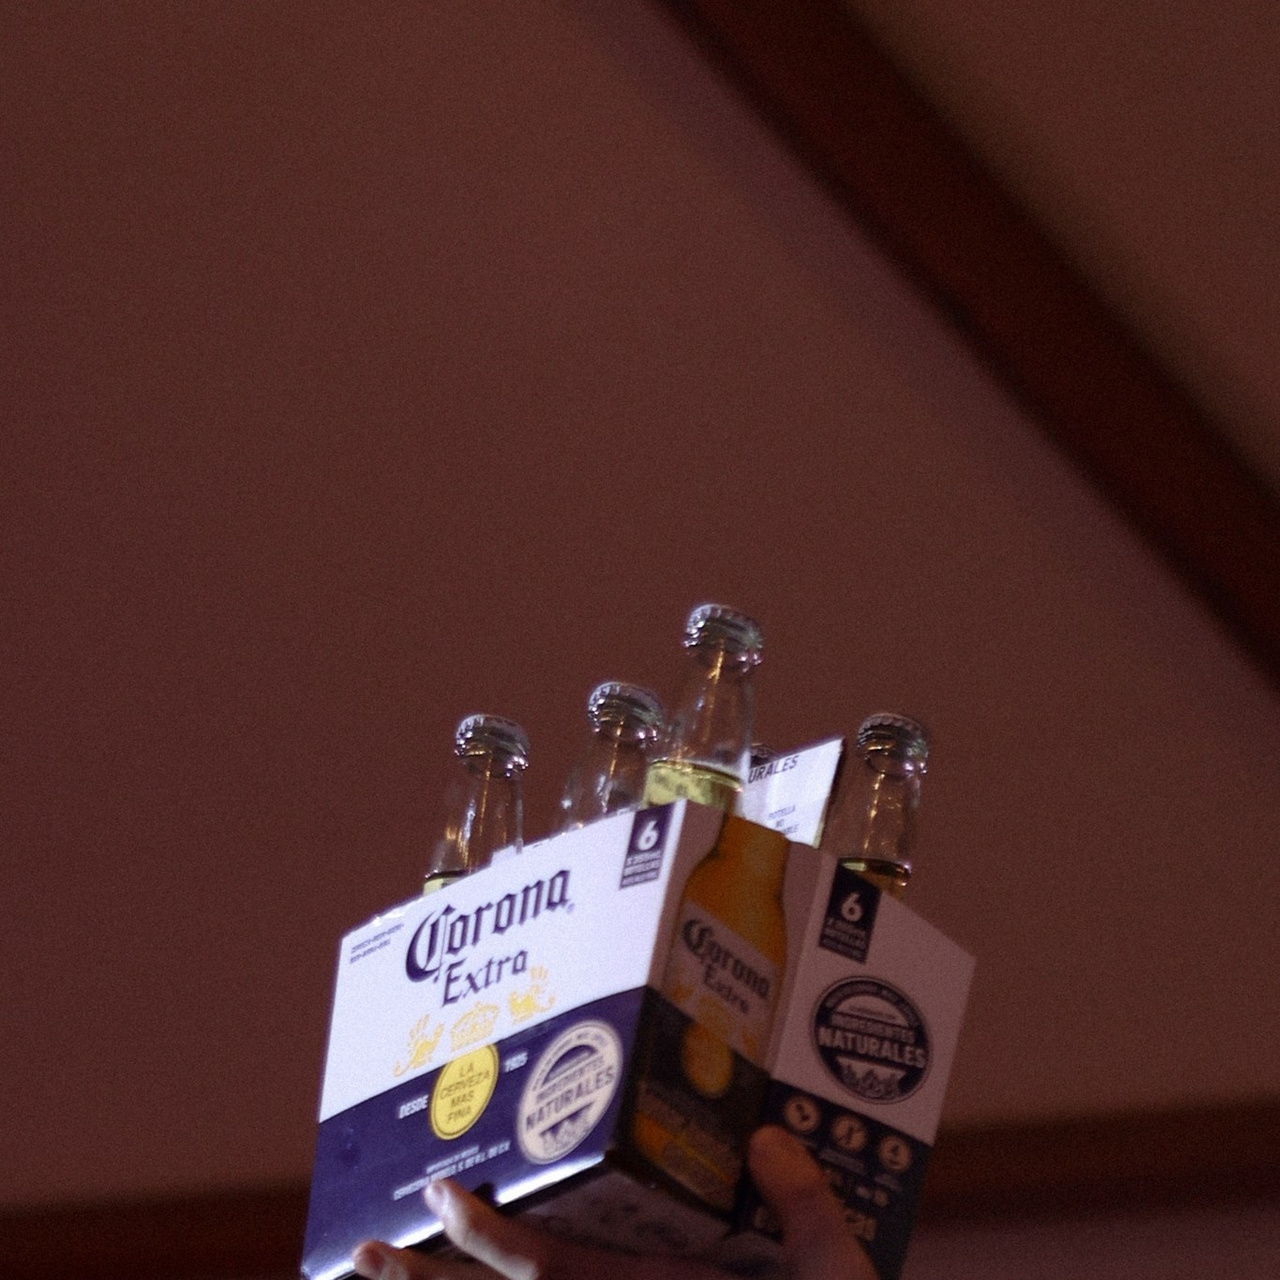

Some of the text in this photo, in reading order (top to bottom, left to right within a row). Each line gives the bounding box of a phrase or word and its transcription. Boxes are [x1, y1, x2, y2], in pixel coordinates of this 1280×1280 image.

[638, 820, 660, 851] 6
[405, 869, 571, 984] Corona
[841, 892, 863, 922] 6
[442, 950, 528, 1007] Extra
[682, 919, 770, 999] Corona
[819, 1026, 927, 1069] NATURALES
[525, 1065, 615, 1132] NATURALES
